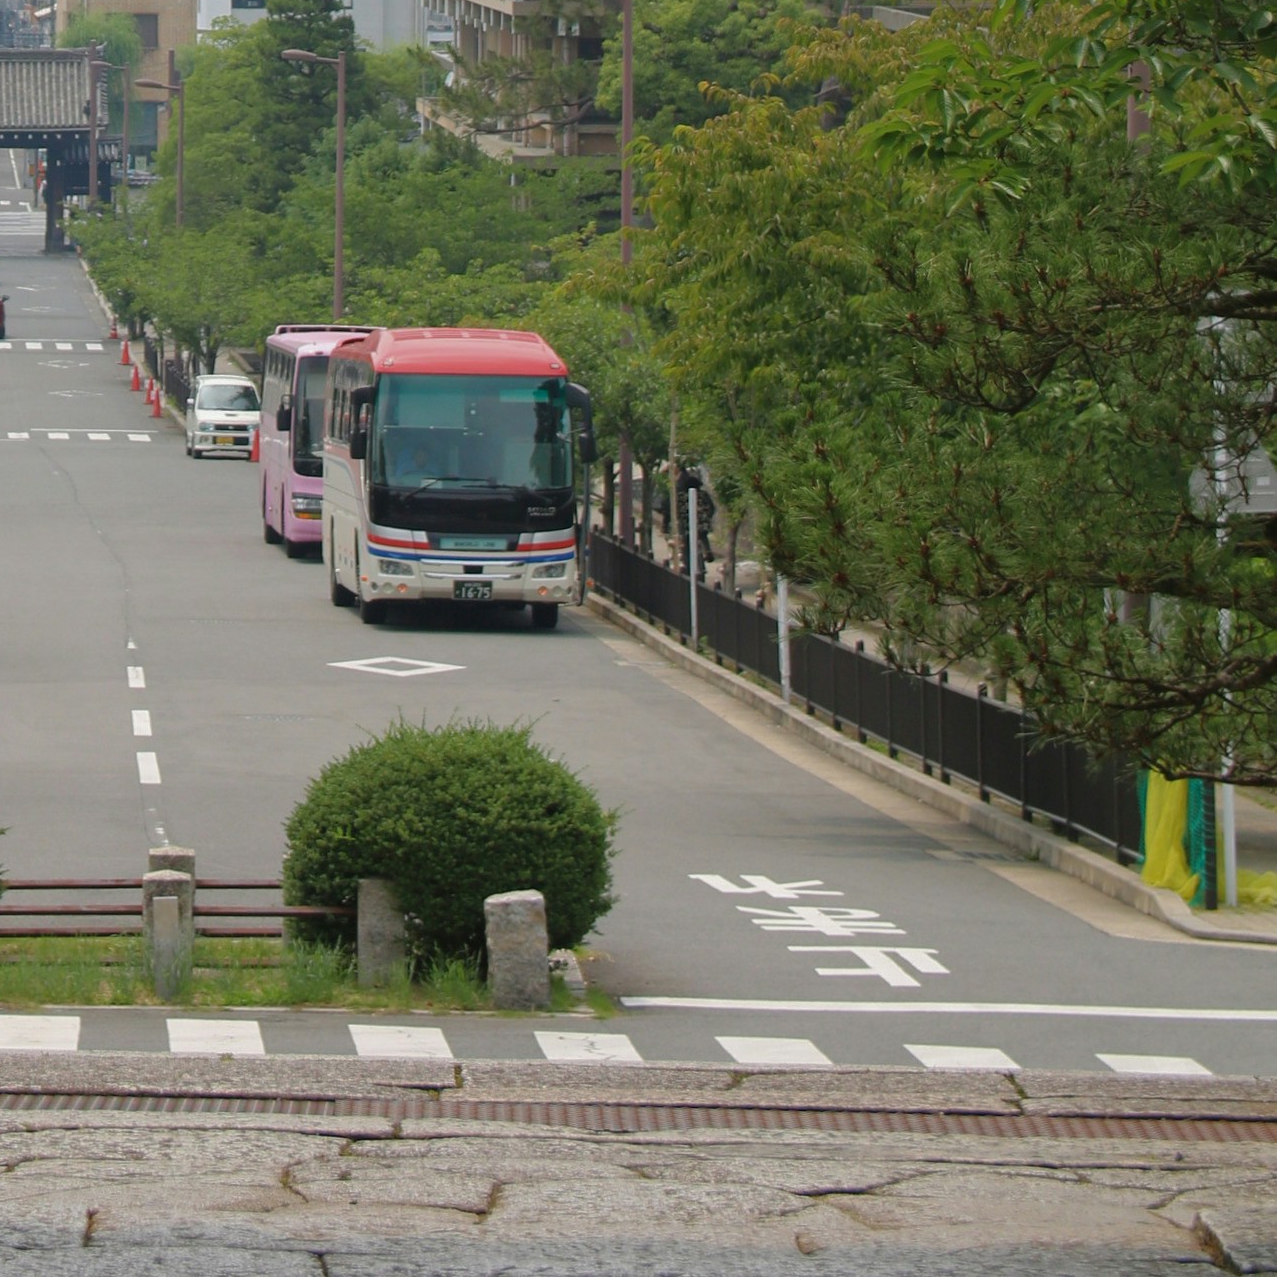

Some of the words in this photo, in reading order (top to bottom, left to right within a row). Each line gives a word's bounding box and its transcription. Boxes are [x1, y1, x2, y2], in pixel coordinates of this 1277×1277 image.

[461, 587, 491, 599] 16-75
[687, 874, 950, 987] 止まれ
